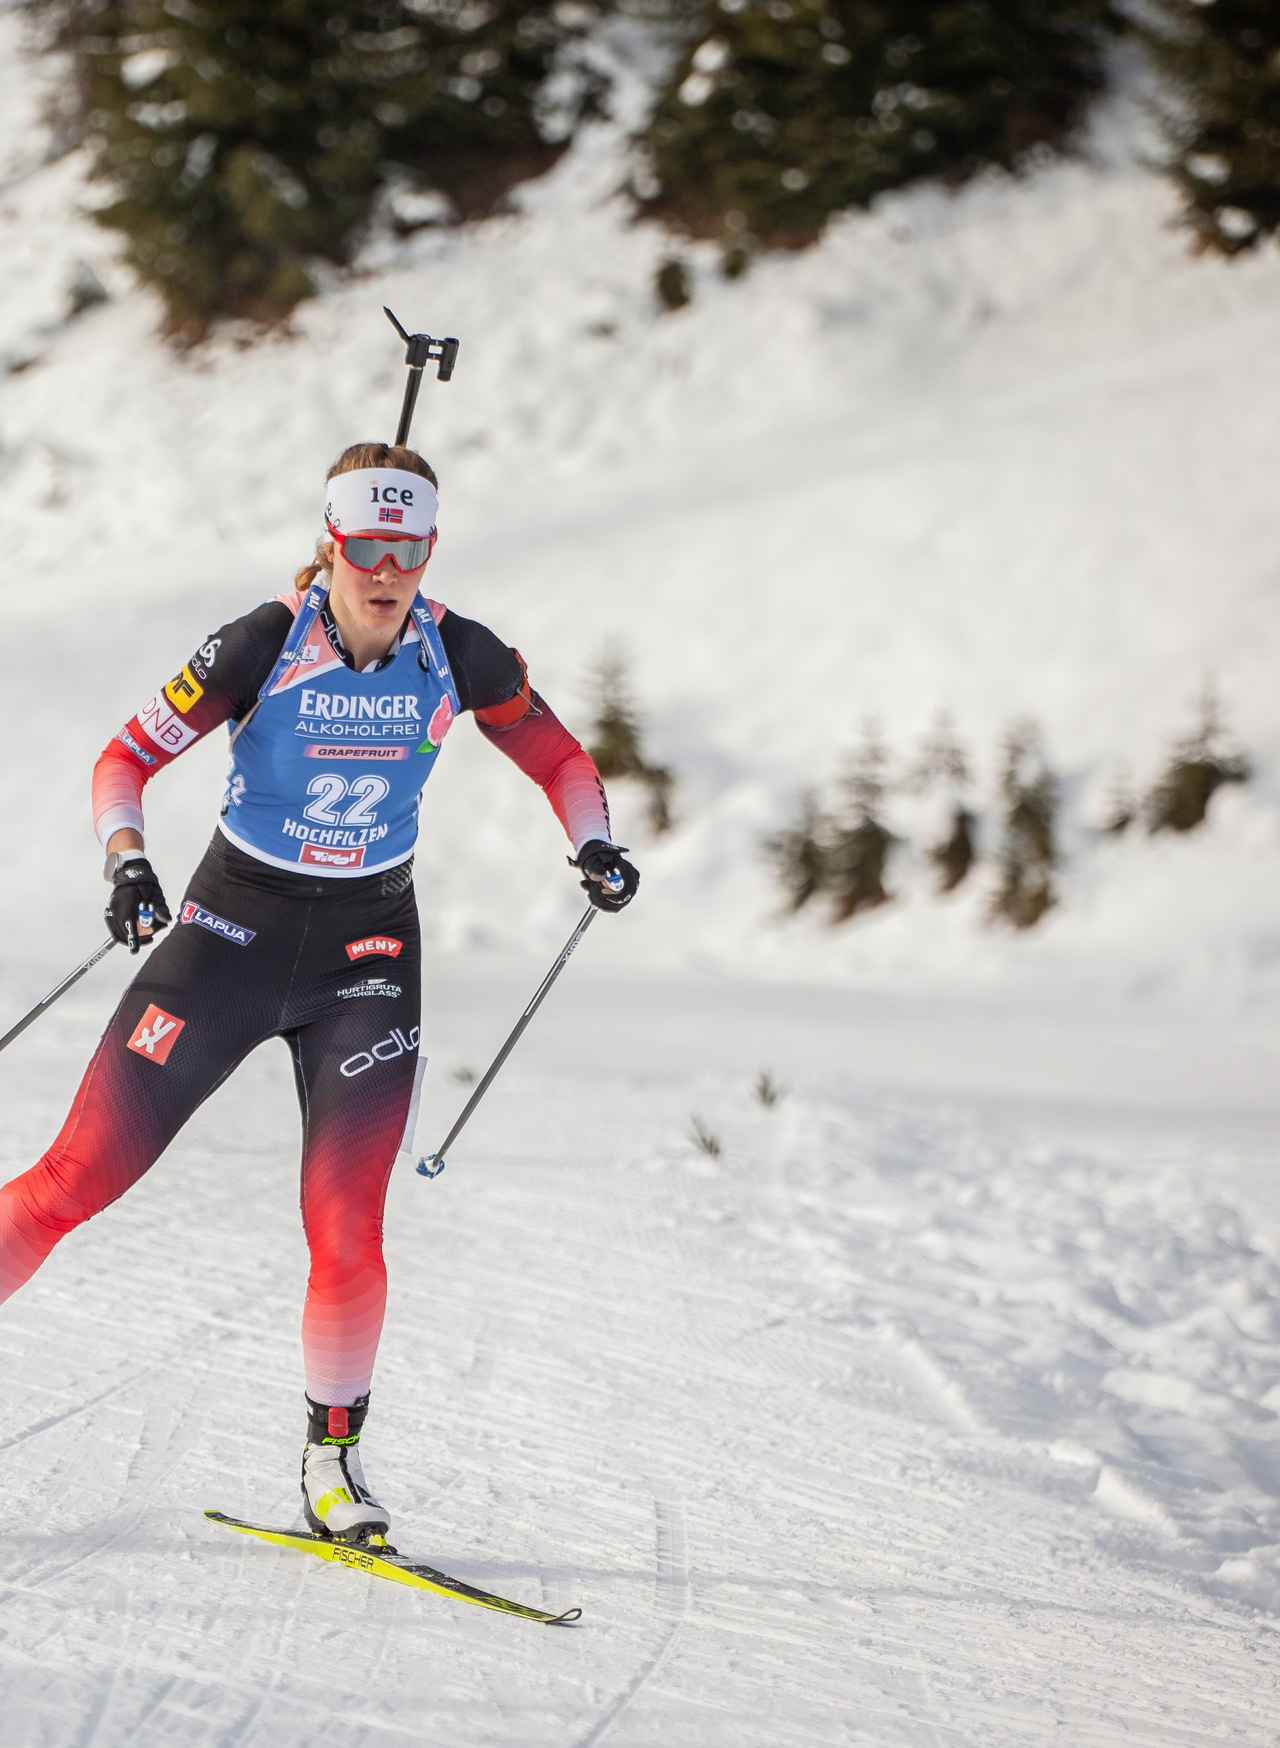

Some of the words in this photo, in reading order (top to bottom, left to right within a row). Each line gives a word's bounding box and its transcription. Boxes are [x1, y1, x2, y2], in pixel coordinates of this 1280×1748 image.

[370, 480, 414, 507] ice
[298, 689, 422, 720] ERDINGER
[140, 697, 184, 746] DNB
[294, 720, 420, 737] ALKOHOLFREI
[317, 748, 399, 758] GRAPEFRUIT
[302, 773, 391, 827] 22
[282, 818, 389, 847] HOCHFILZEN
[310, 850, 357, 866] Tirol
[194, 911, 247, 943] LAPUA
[351, 940, 398, 956] MENY
[337, 984, 402, 997] HURTIGRUTA
[332, 1547, 375, 1571] FISCHER
